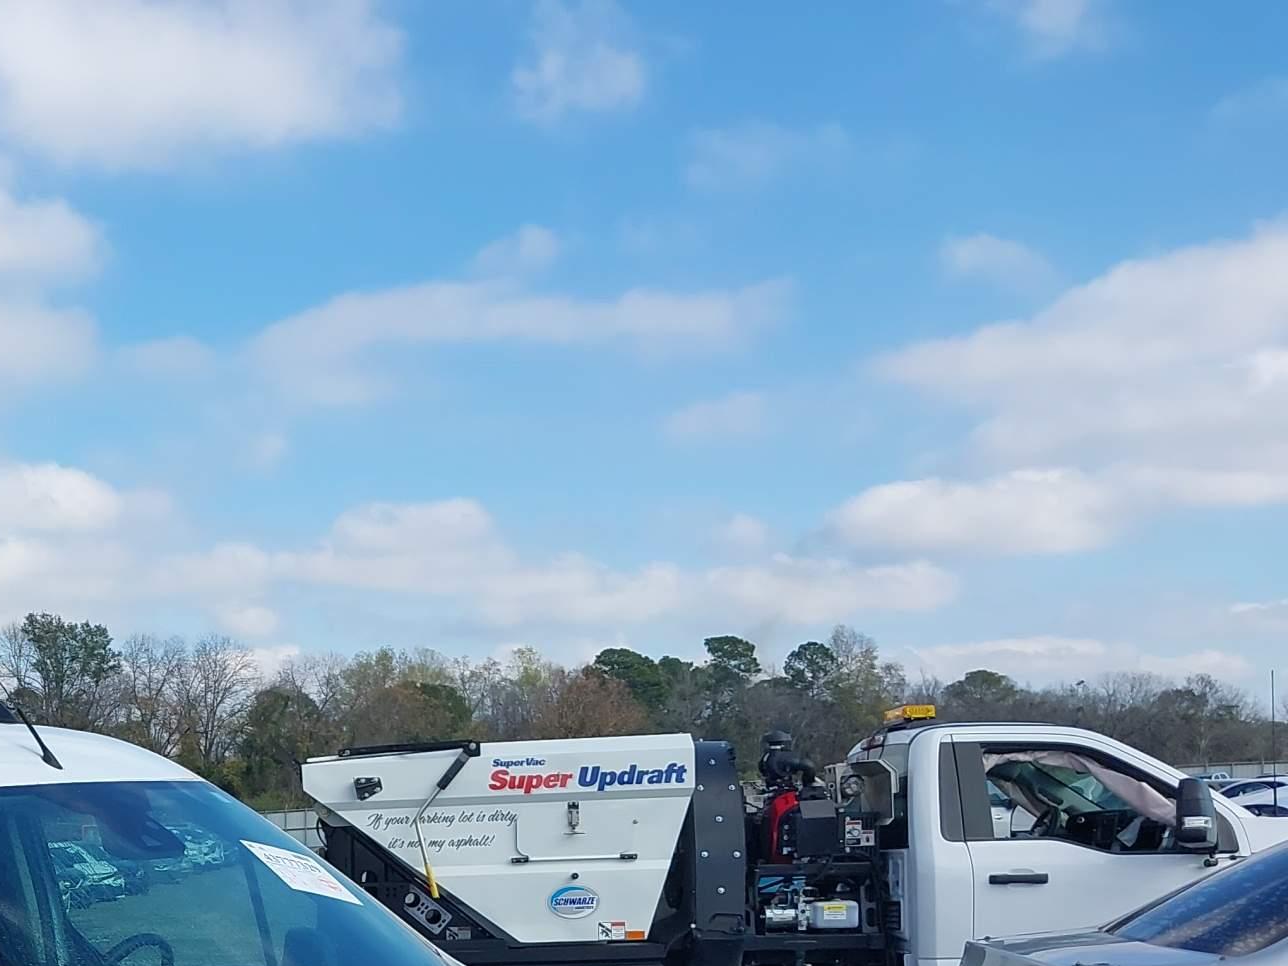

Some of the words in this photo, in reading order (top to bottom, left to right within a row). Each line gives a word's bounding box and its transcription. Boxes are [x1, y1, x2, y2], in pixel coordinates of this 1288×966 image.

[492, 758, 546, 769] SuperVac
[488, 769, 573, 794] Super
[578, 763, 688, 791] Updraft
[367, 813, 383, 830] If
[384, 816, 410, 830] your
[458, 810, 474, 823] lot
[476, 811, 486, 823] is
[388, 837, 405, 849] it's
[407, 837, 426, 849] no
[428, 838, 446, 852] my
[448, 834, 496, 849] asphalt!
[553, 896, 595, 906] SCHWARZE
